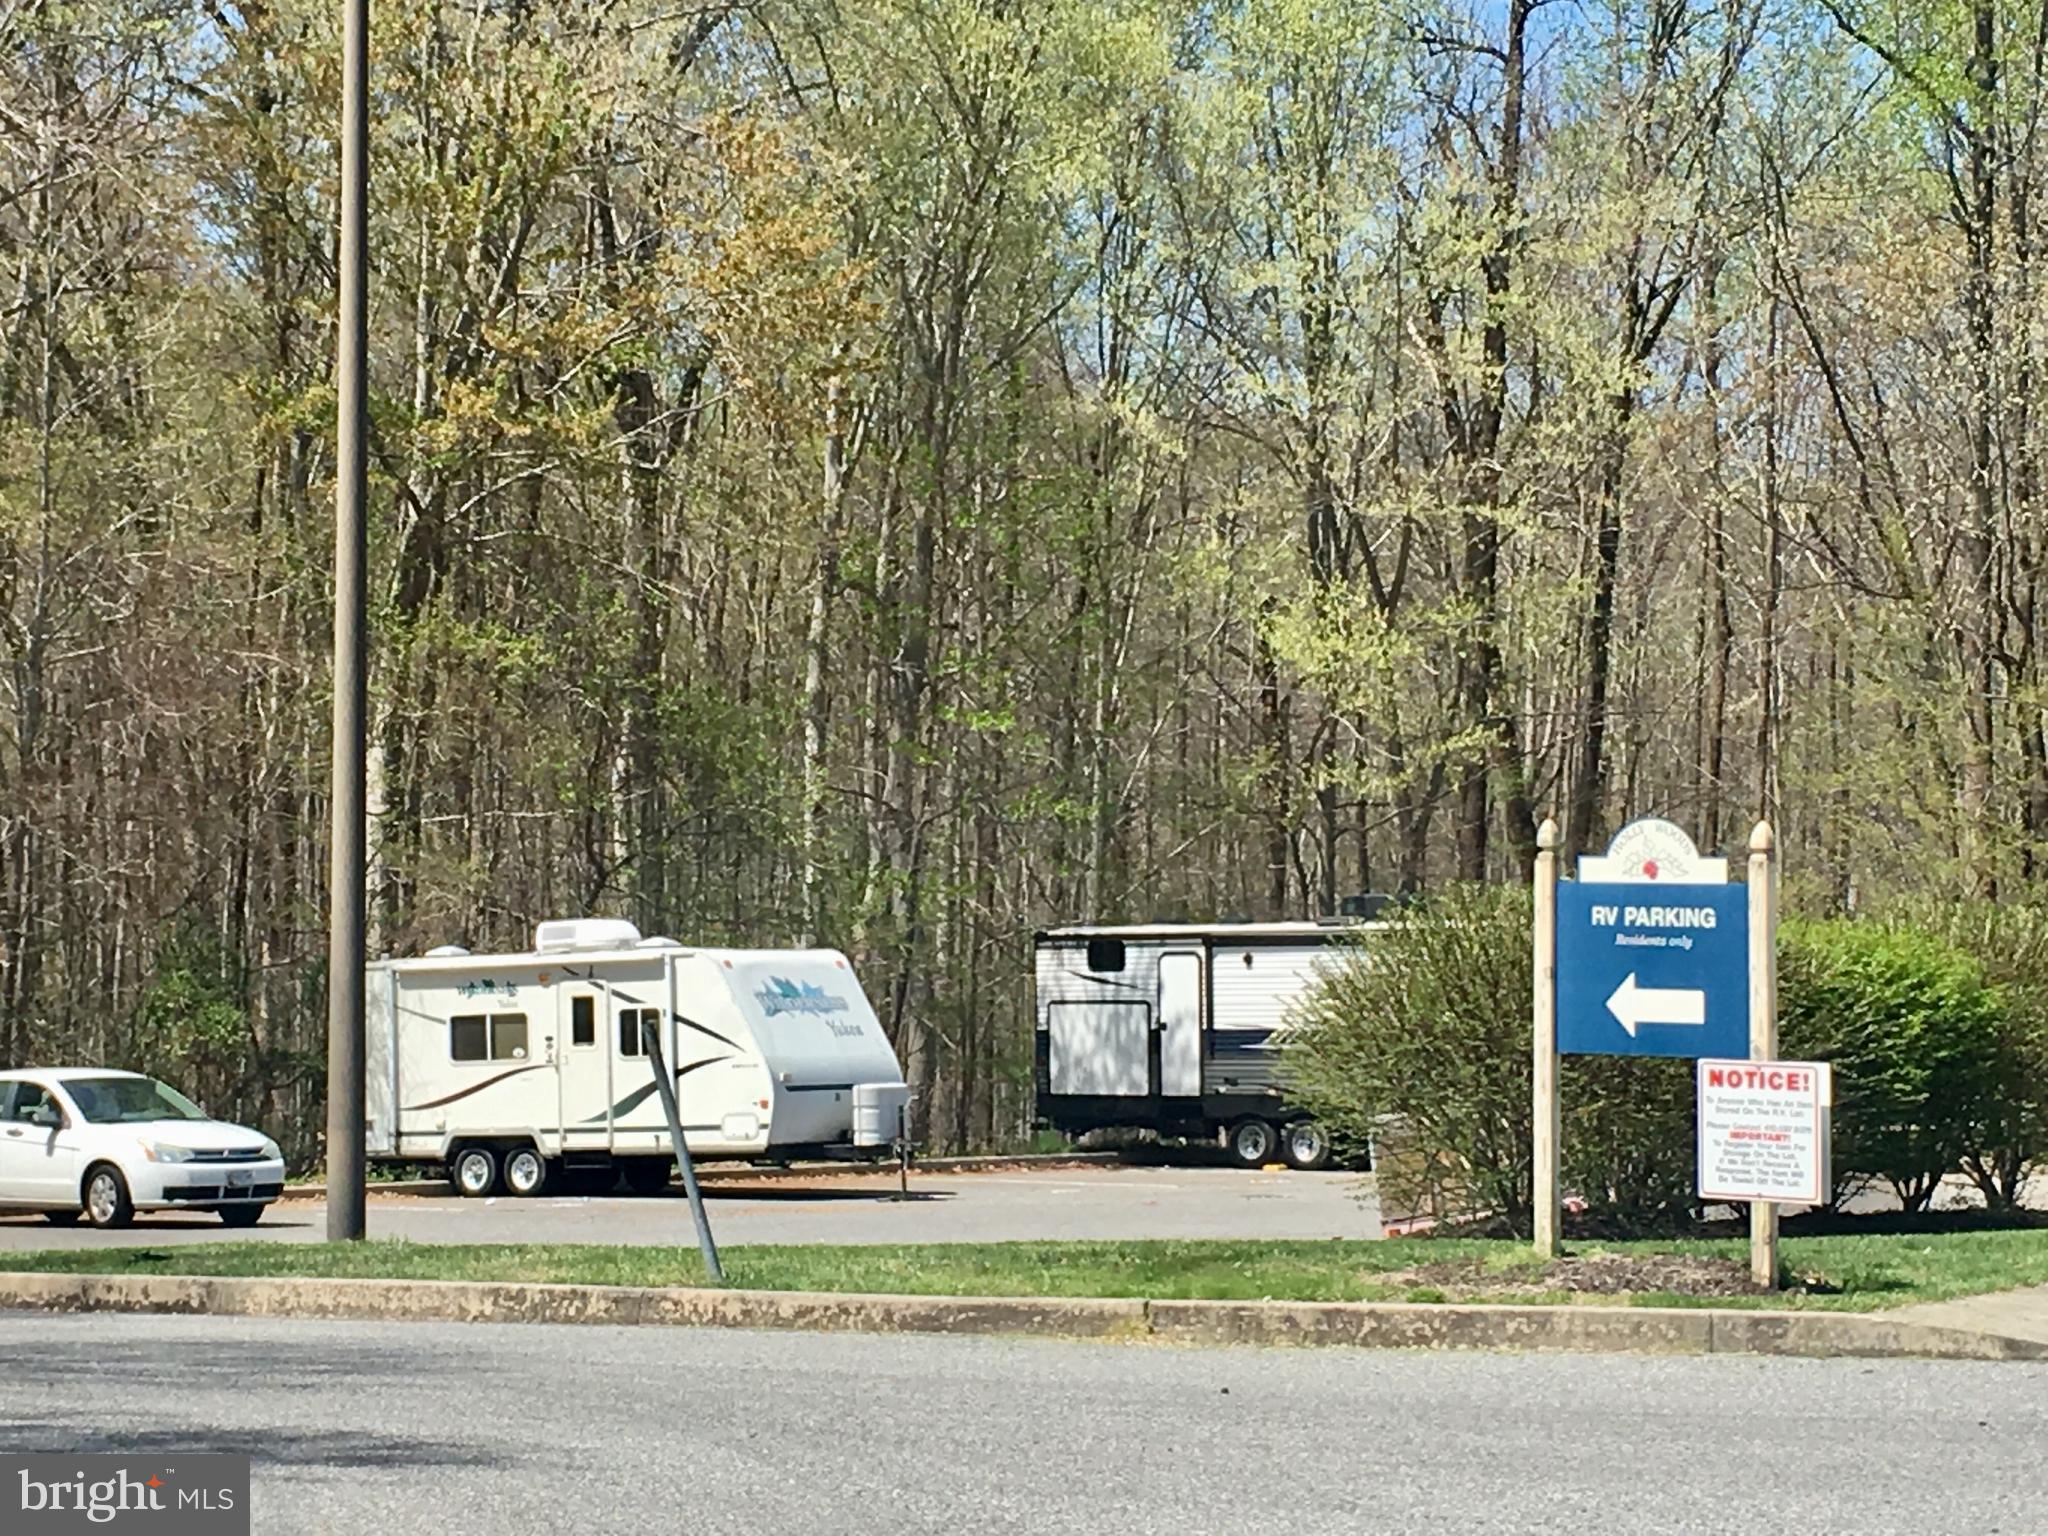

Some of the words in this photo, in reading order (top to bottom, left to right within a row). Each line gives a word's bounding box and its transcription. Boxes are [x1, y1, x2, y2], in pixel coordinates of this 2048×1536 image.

[1591, 906, 1618, 926] RV
[1624, 906, 1717, 929] PARKING
[1615, 933, 1667, 946] Residents
[1668, 935, 1693, 950] only
[1708, 1069, 1810, 1092] NOTICE!
